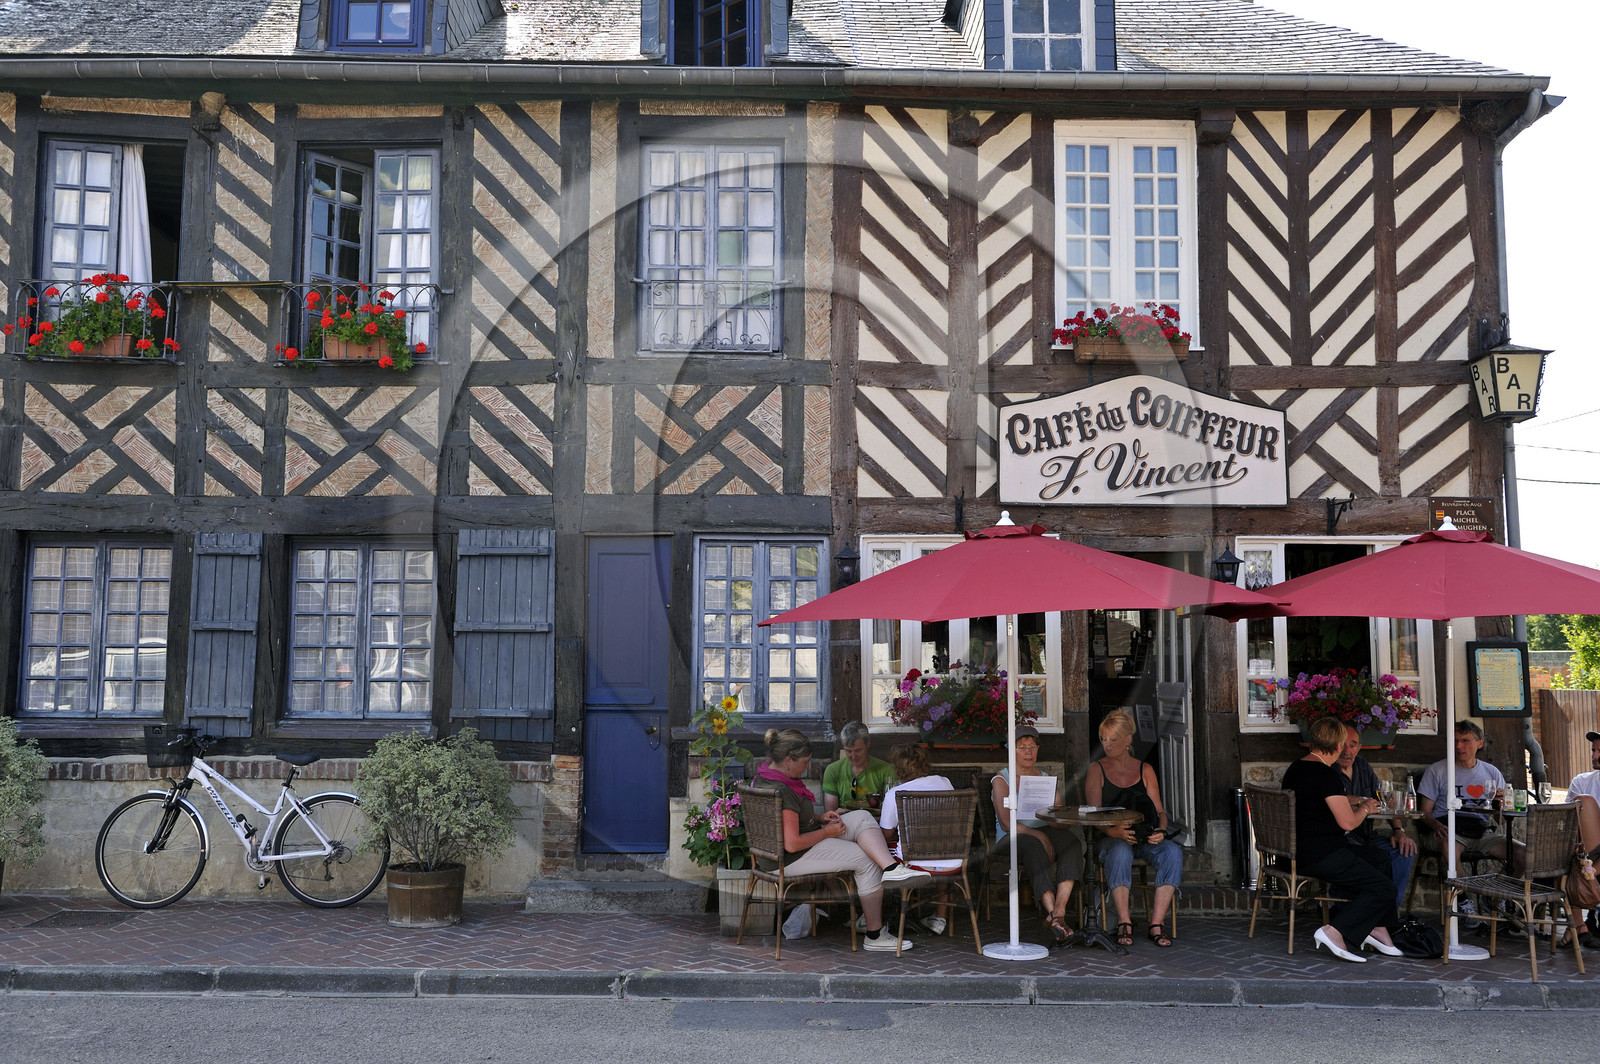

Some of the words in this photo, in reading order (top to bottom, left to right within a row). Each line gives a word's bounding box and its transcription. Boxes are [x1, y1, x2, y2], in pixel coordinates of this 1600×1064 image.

[1472, 364, 1497, 413] BAR
[1496, 357, 1532, 410] BAR
[1005, 401, 1099, 457] CAFÉ
[1095, 402, 1127, 432] du
[1127, 386, 1281, 462] COIFFEUR
[1094, 438, 1249, 497] Vincent
